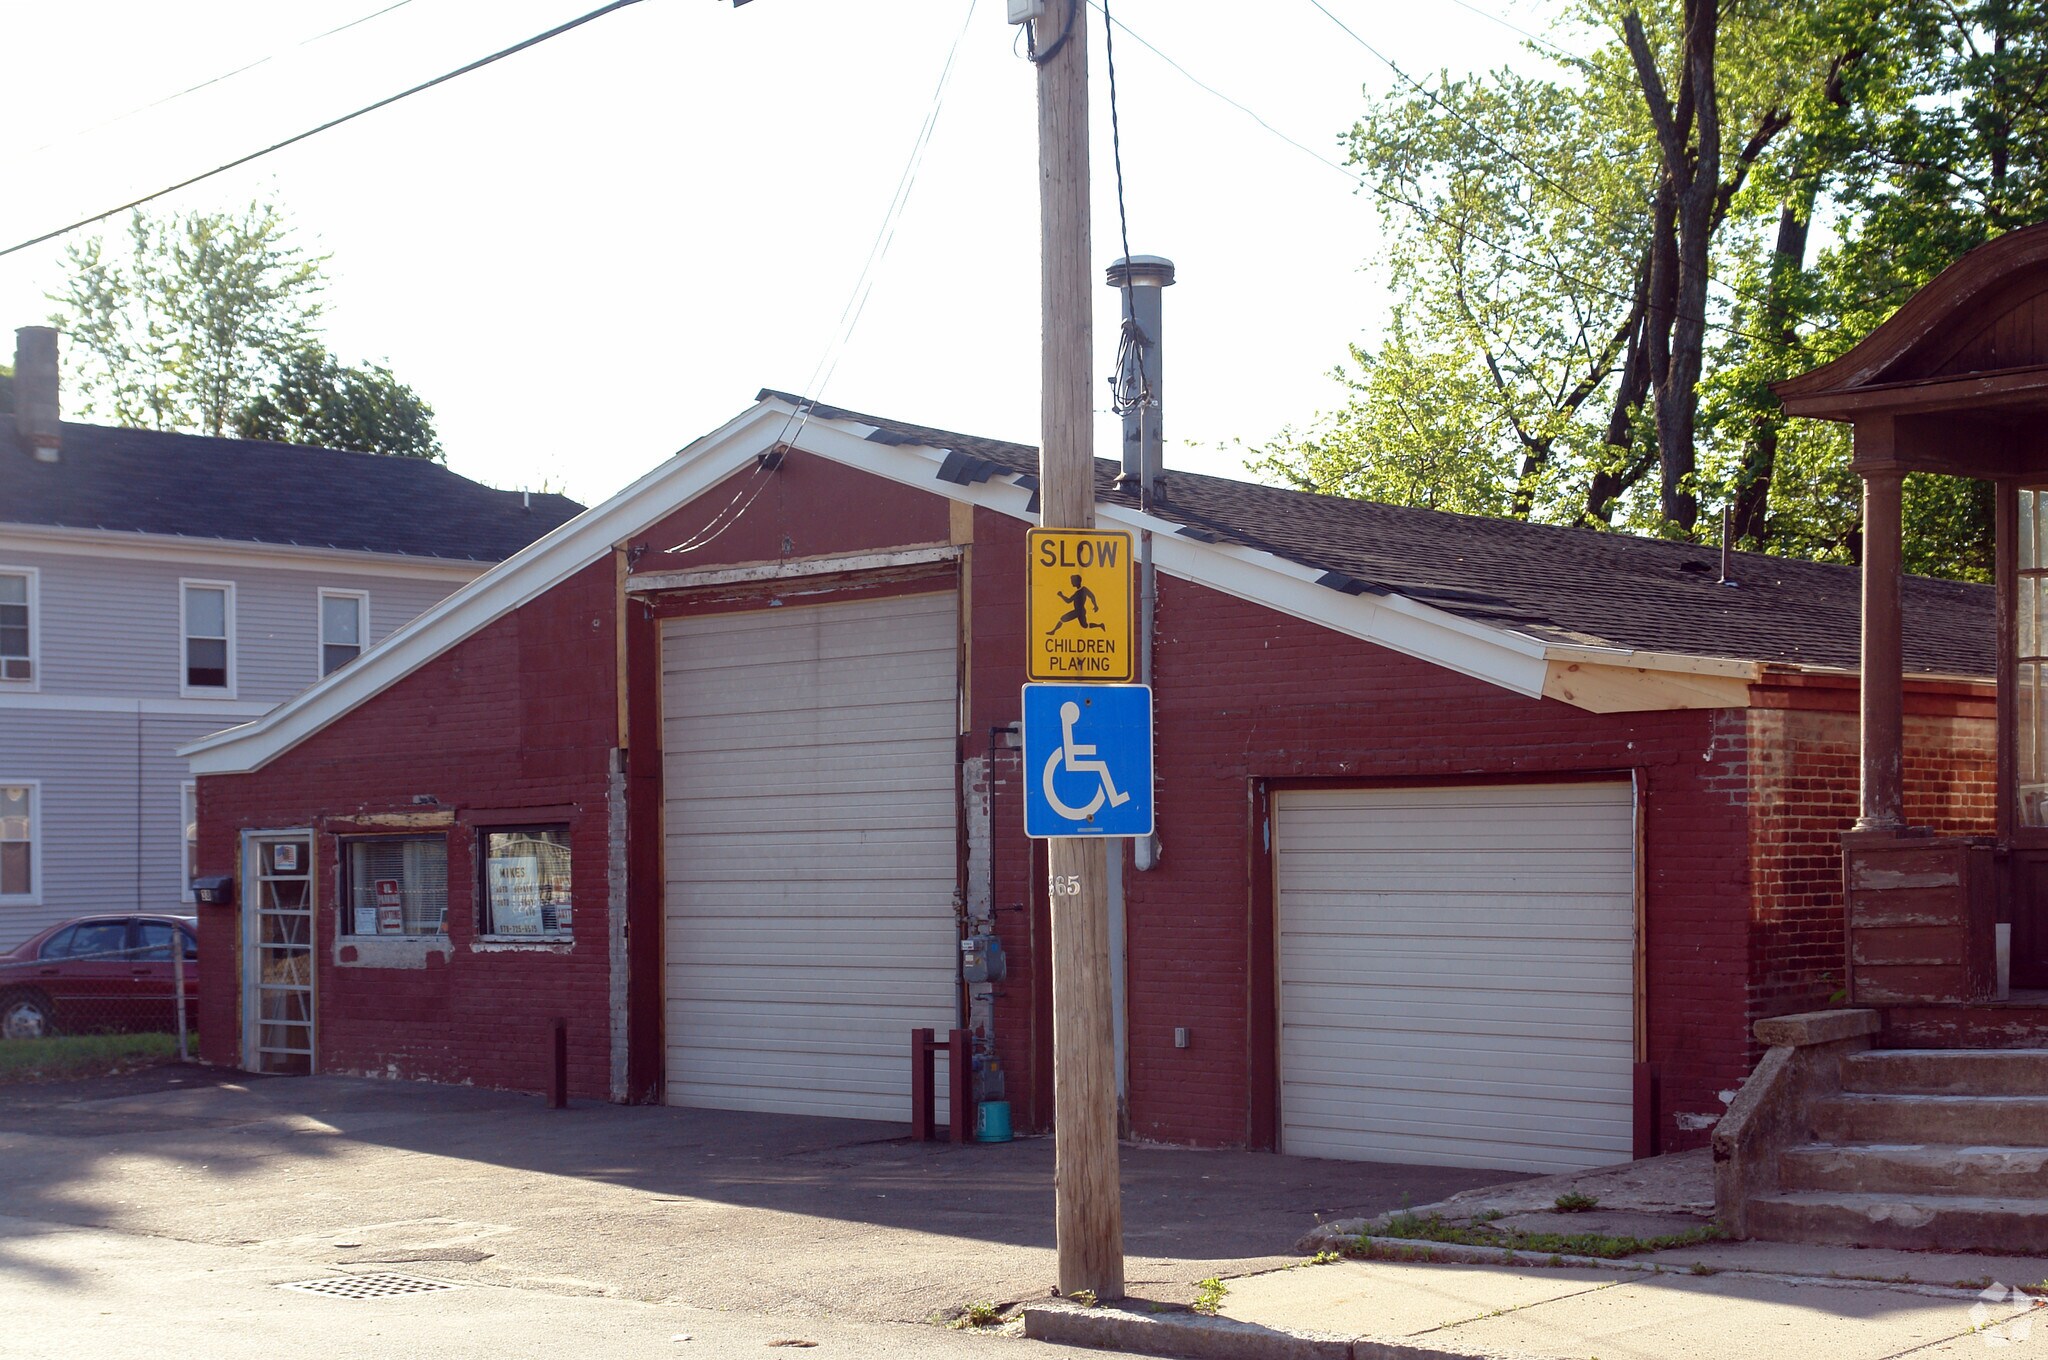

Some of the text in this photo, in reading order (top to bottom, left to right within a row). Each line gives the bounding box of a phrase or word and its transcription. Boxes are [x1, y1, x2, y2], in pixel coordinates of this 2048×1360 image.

[1040, 539, 1117, 568] SLOW
[1045, 638, 1115, 653] CHILDREN
[1050, 656, 1110, 671] PLAYING
[500, 867, 526, 878] MIKES
